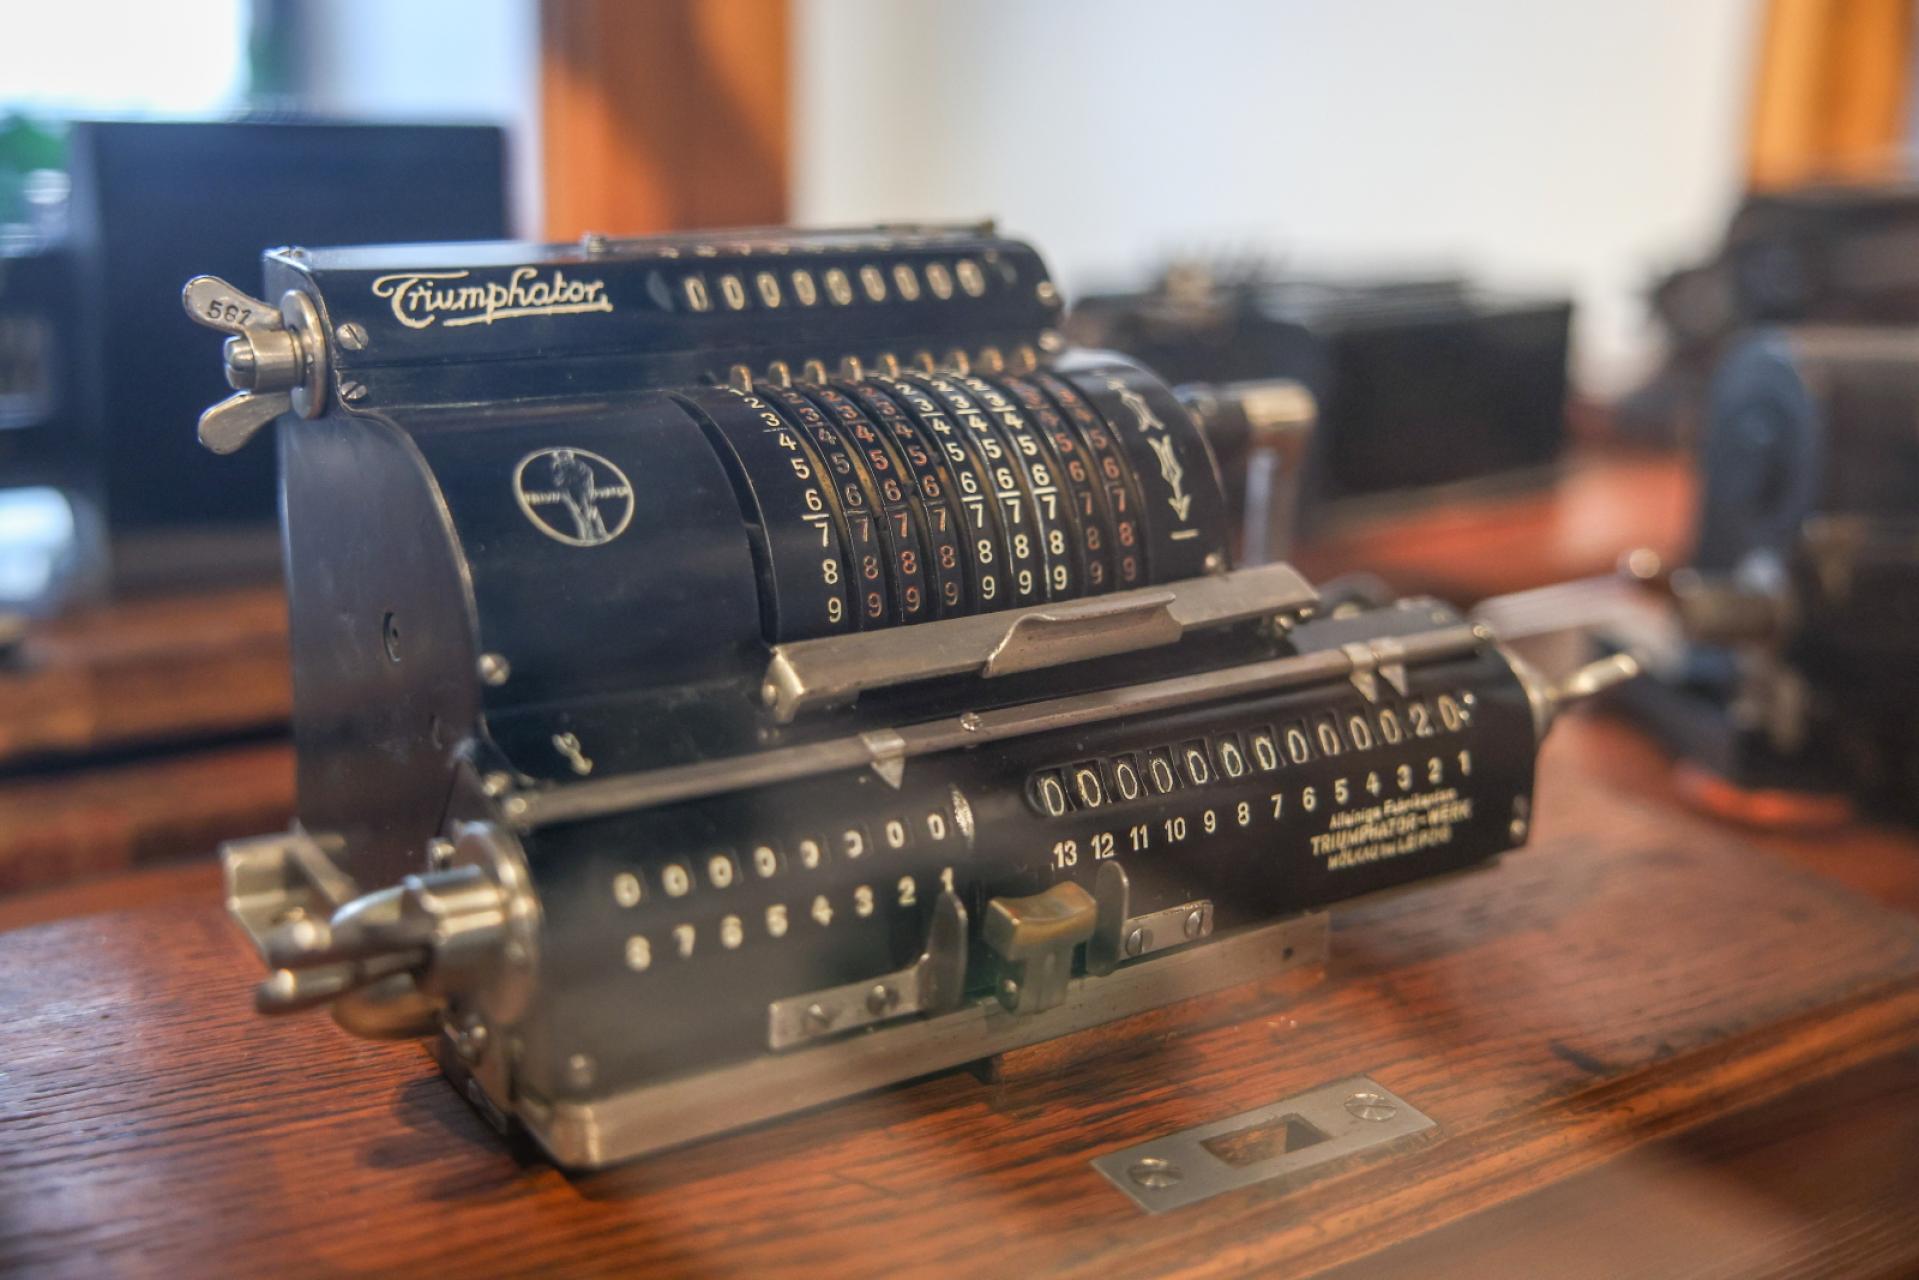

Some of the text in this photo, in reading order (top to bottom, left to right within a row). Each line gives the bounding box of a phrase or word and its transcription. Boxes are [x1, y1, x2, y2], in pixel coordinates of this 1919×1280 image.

[372, 267, 613, 329] Triumphator
[684, 276, 709, 312] 0
[721, 274, 744, 310] 0
[757, 272, 781, 308] 0
[744, 398, 765, 408] 2
[800, 408, 819, 421] 3
[836, 405, 858, 418] 3
[760, 412, 780, 427] 3
[896, 422, 912, 438] 4
[780, 433, 796, 450] 4
[856, 425, 874, 442] 4
[1055, 433, 1072, 452] 5
[1090, 429, 1106, 448] 5
[831, 452, 849, 474] 5
[871, 450, 888, 470] 5
[908, 446, 927, 465] 5
[1104, 456, 1119, 478] 6
[791, 458, 810, 480] 5
[1069, 461, 1084, 482] 6
[846, 484, 861, 506] 6
[884, 479, 900, 500] 6
[895, 383, 995, 600] 2 3 4 5 6 7 8 9
[922, 474, 940, 496] 6
[932, 380, 1032, 594] 2 3 4 5 6 7 8 9
[966, 378, 1068, 590] 2 3 4 5 6 7 8 9
[806, 488, 822, 510] 6
[1080, 492, 1092, 514] 7
[1112, 488, 1126, 512] 7
[856, 518, 868, 542] 7
[895, 513, 908, 538] 7
[934, 508, 946, 531] 7
[814, 522, 828, 547] 7
[1087, 526, 1099, 550] 8
[1119, 522, 1134, 546] 8
[864, 555, 878, 580] 8
[902, 551, 916, 574] 8
[940, 545, 955, 568] 8
[822, 559, 838, 584] 8
[1091, 561, 1102, 584] 9
[1124, 556, 1136, 581] 9
[868, 592, 882, 617] 9
[906, 586, 920, 612] 9
[944, 582, 958, 606] 9
[828, 597, 842, 623] 9
[1041, 694, 1462, 816] 0 0 0 0 0 0 0 0 0 0 0 2 0
[1054, 750, 1472, 868] 13 12 11 10 9 8 7 6 5 4 3 2 1
[662, 863, 689, 897] 0
[708, 855, 733, 888] 0
[754, 846, 776, 878] 0
[886, 820, 904, 848] 0
[927, 814, 945, 840] 0
[672, 924, 695, 958] 7
[812, 895, 833, 926] 4
[854, 885, 874, 917] 3
[898, 876, 916, 906] 2
[940, 867, 954, 892] 1
